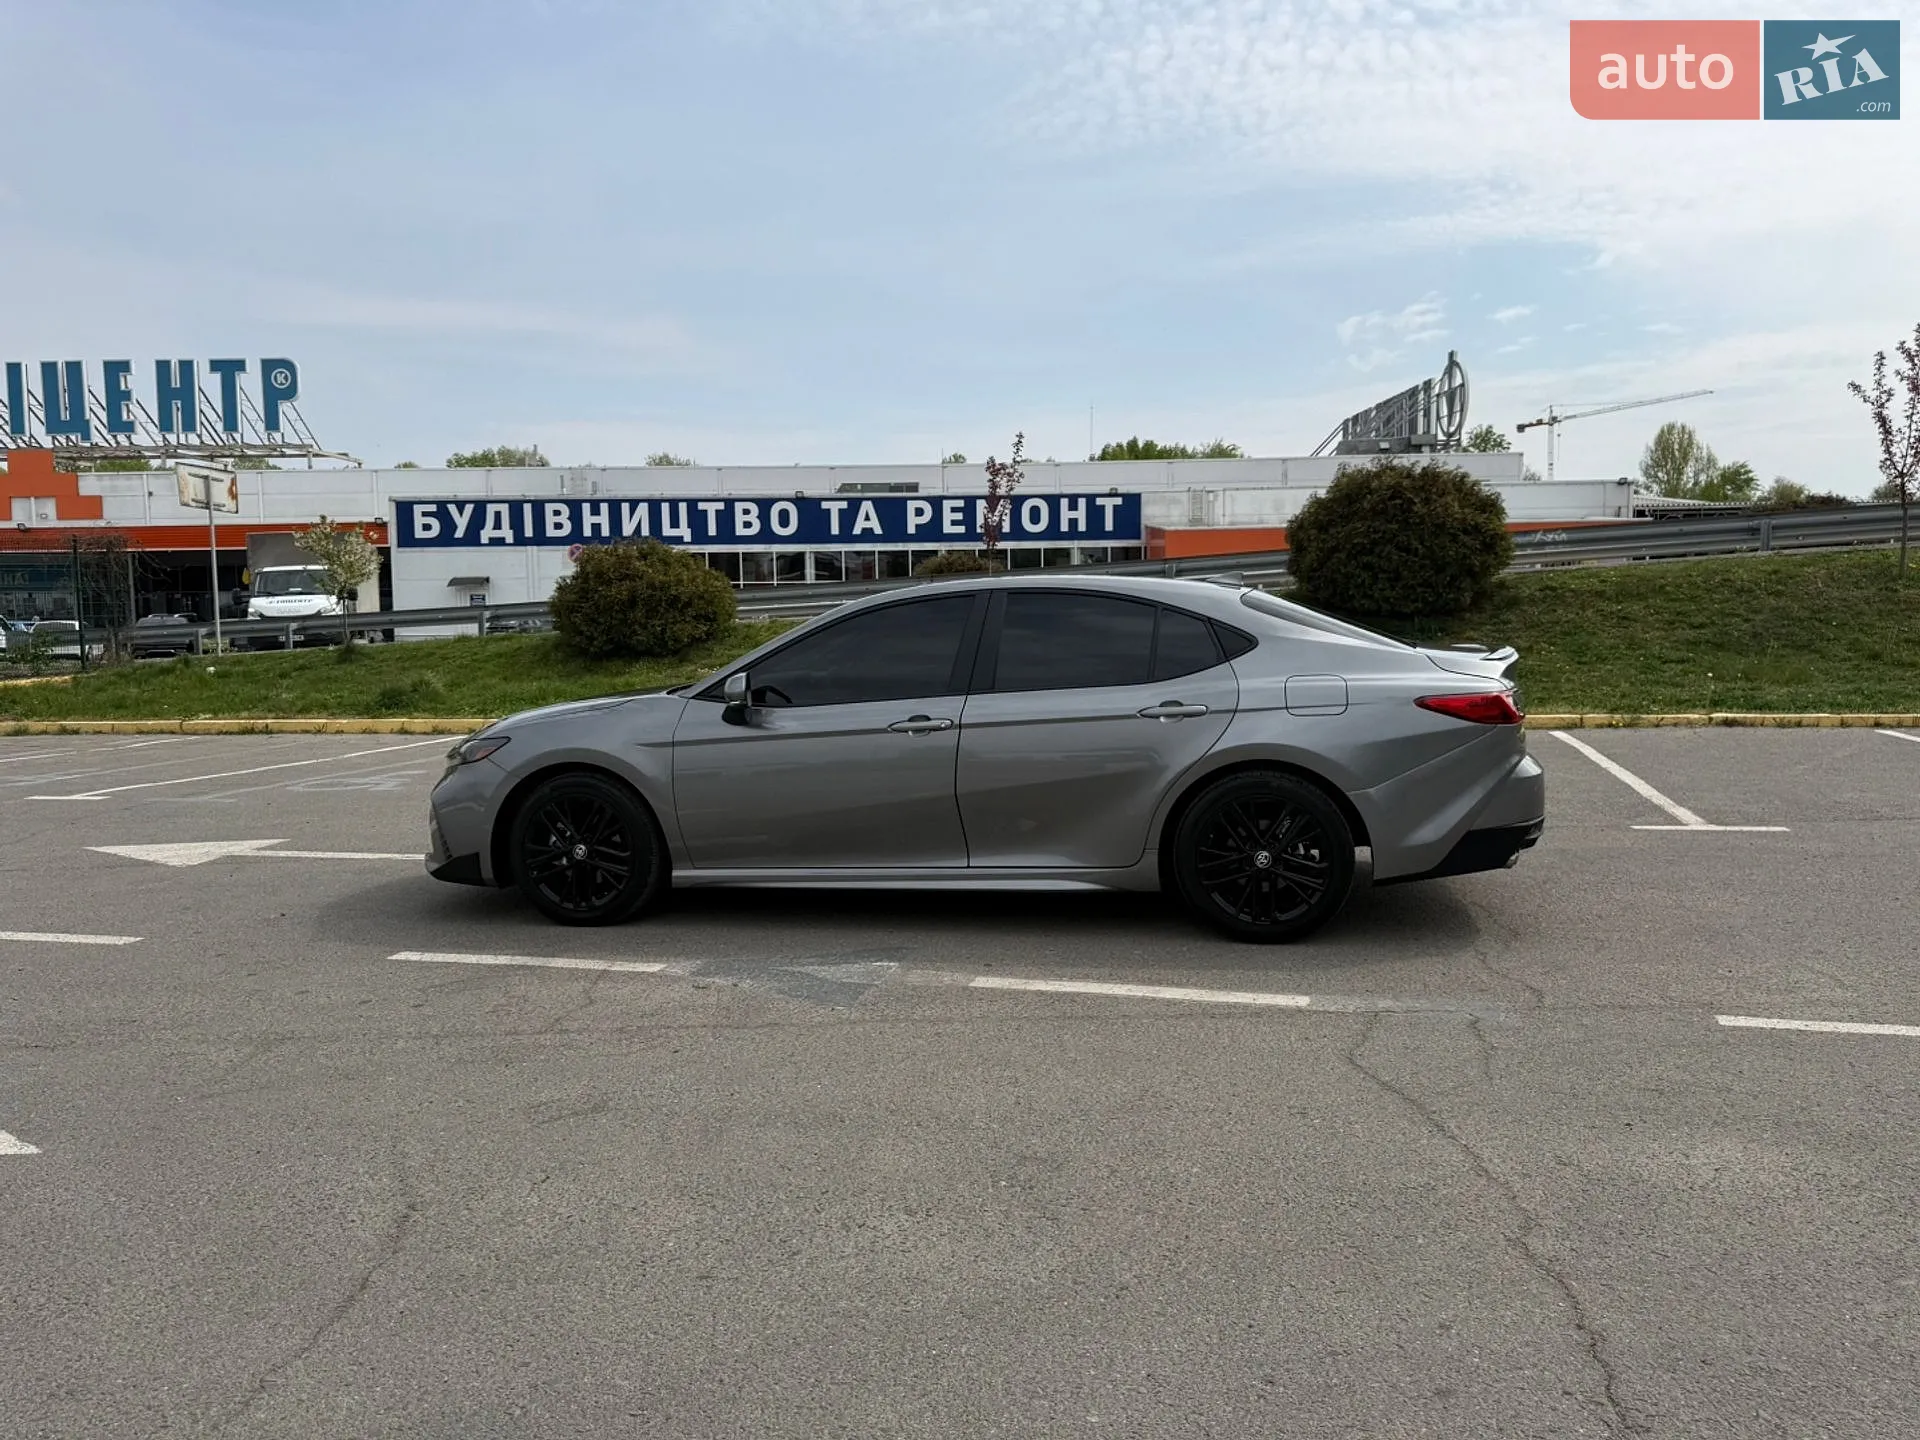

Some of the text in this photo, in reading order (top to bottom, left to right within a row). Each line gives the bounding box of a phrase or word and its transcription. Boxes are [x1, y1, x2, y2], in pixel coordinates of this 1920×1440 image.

[412, 497, 1123, 544] БУДІВНИЦТВО ТА РЕМОНТ
